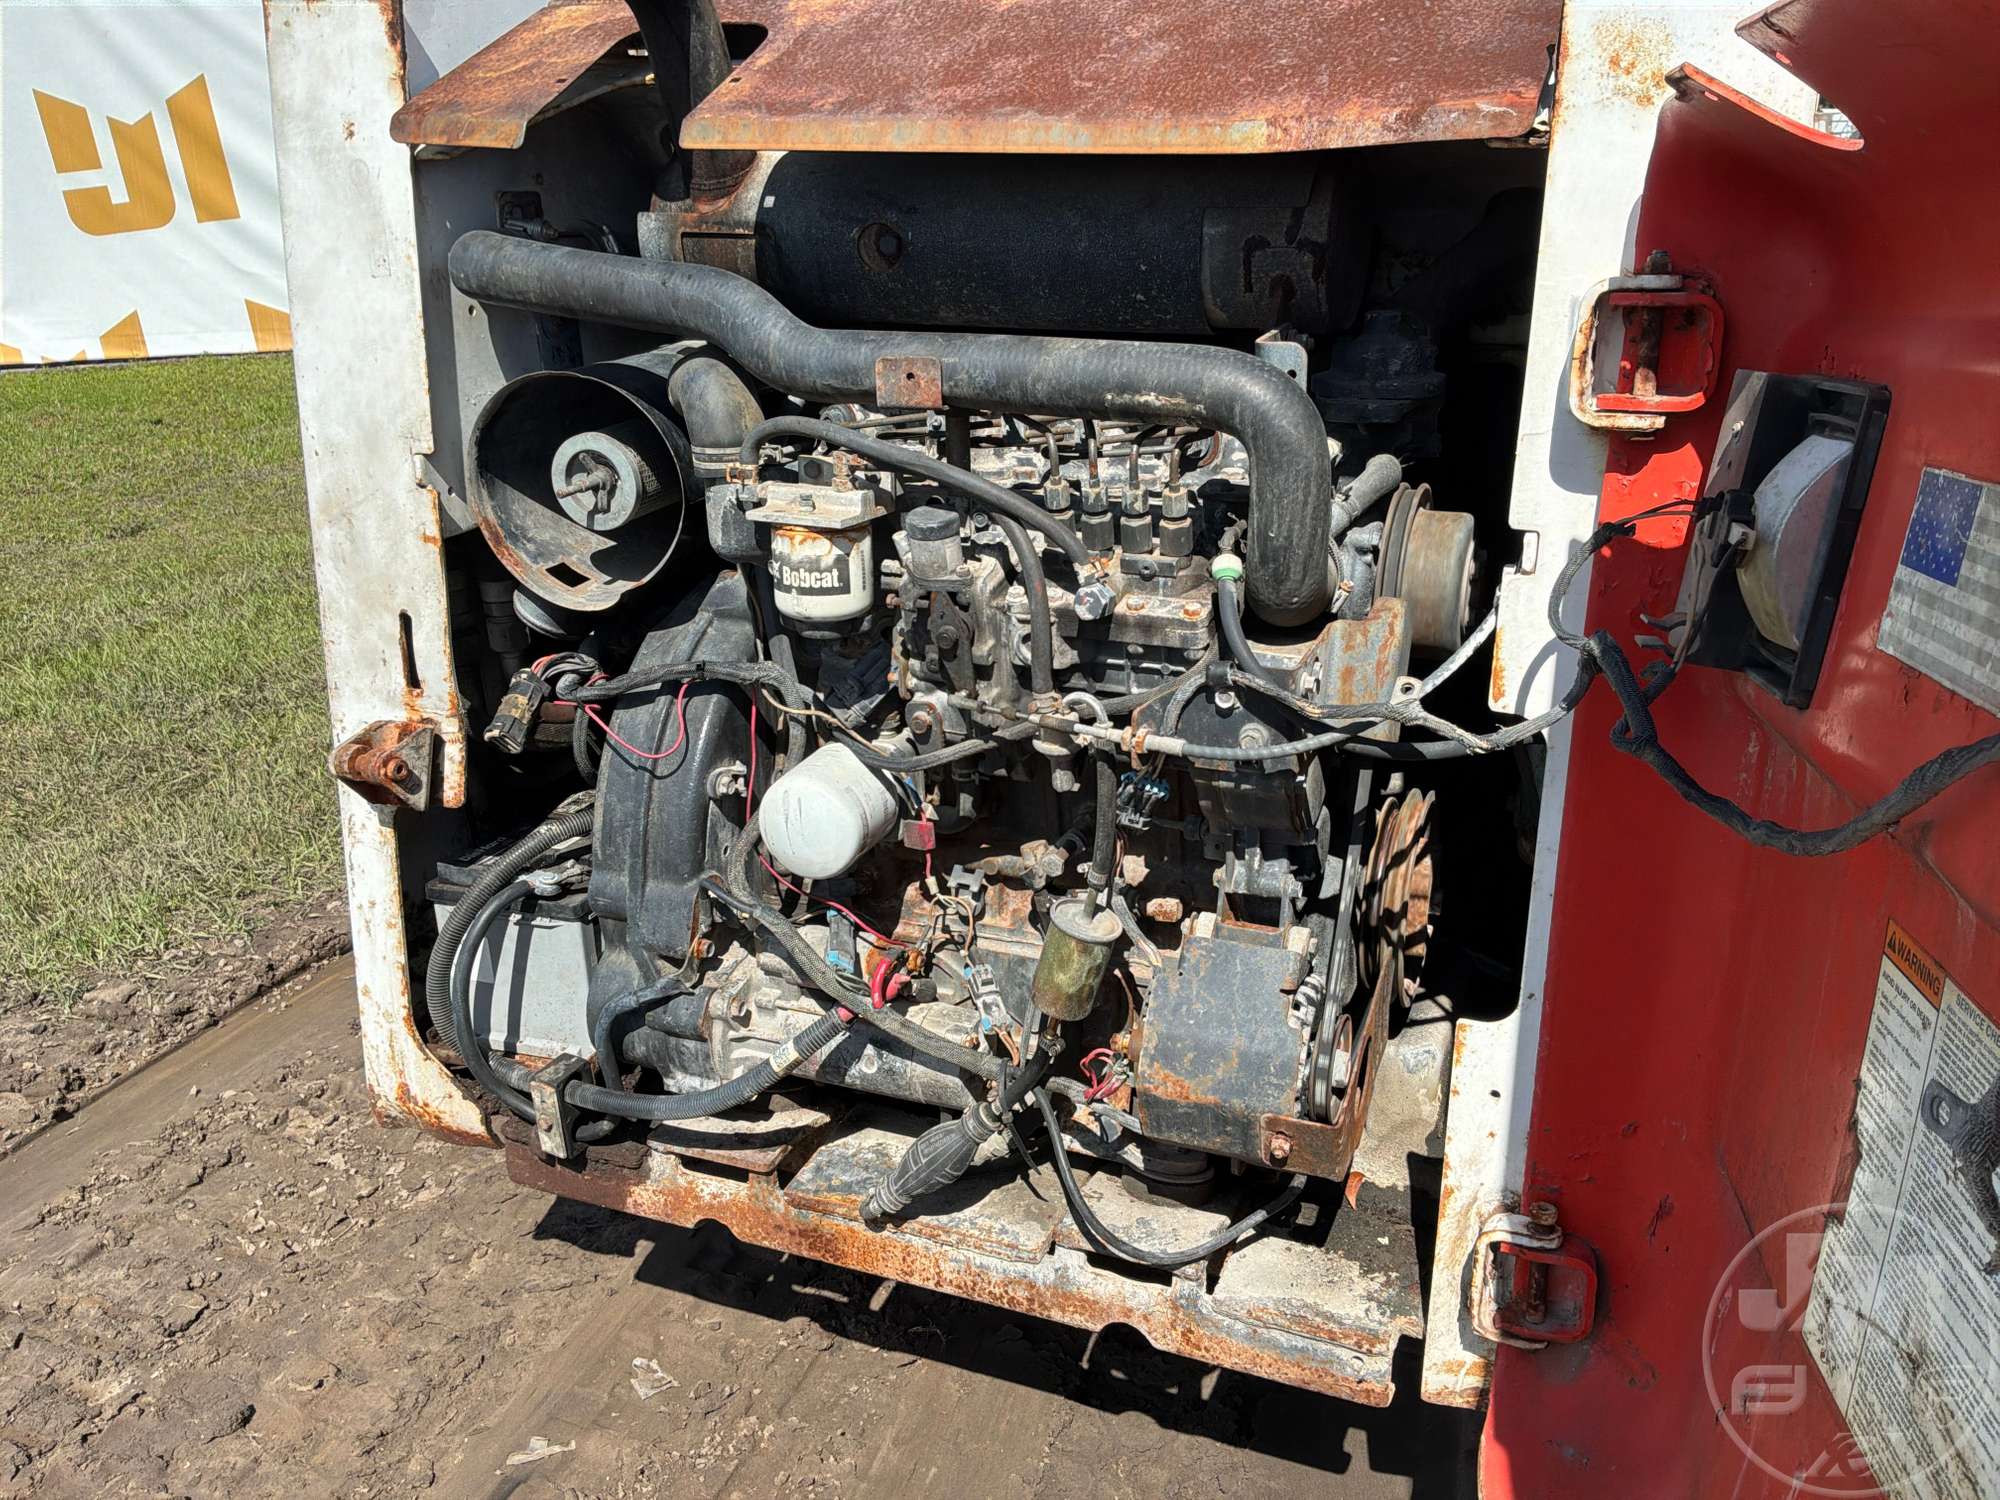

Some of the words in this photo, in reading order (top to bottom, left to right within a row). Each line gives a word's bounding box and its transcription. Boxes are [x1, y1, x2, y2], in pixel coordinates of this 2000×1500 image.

[782, 566, 839, 588] Bobcat
[1897, 938, 1941, 996] WARNING
[1956, 993, 1986, 1031] SERVICE
